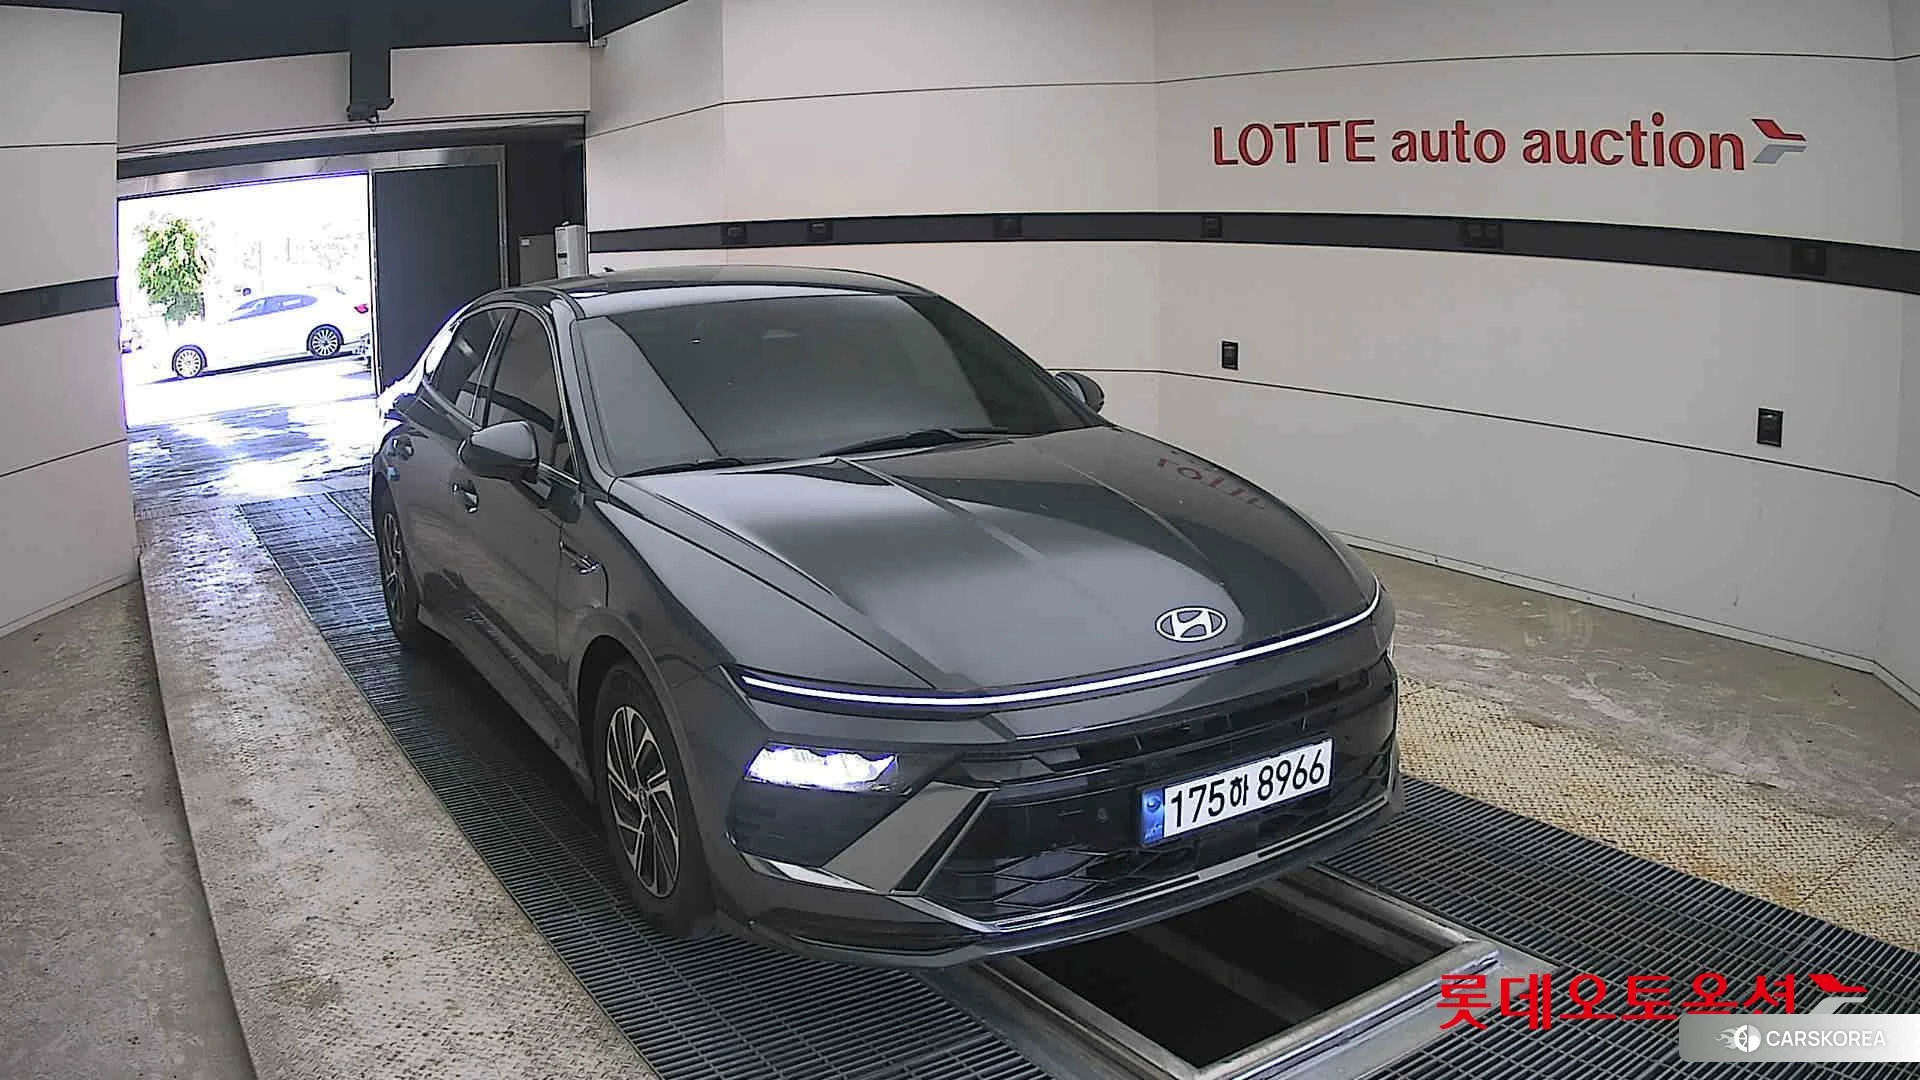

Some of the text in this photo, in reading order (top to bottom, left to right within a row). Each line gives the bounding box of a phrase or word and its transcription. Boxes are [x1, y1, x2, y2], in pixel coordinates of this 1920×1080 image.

[1213, 112, 1745, 171] LOTTE auto auction
[1170, 749, 1325, 828] 175하 8966
